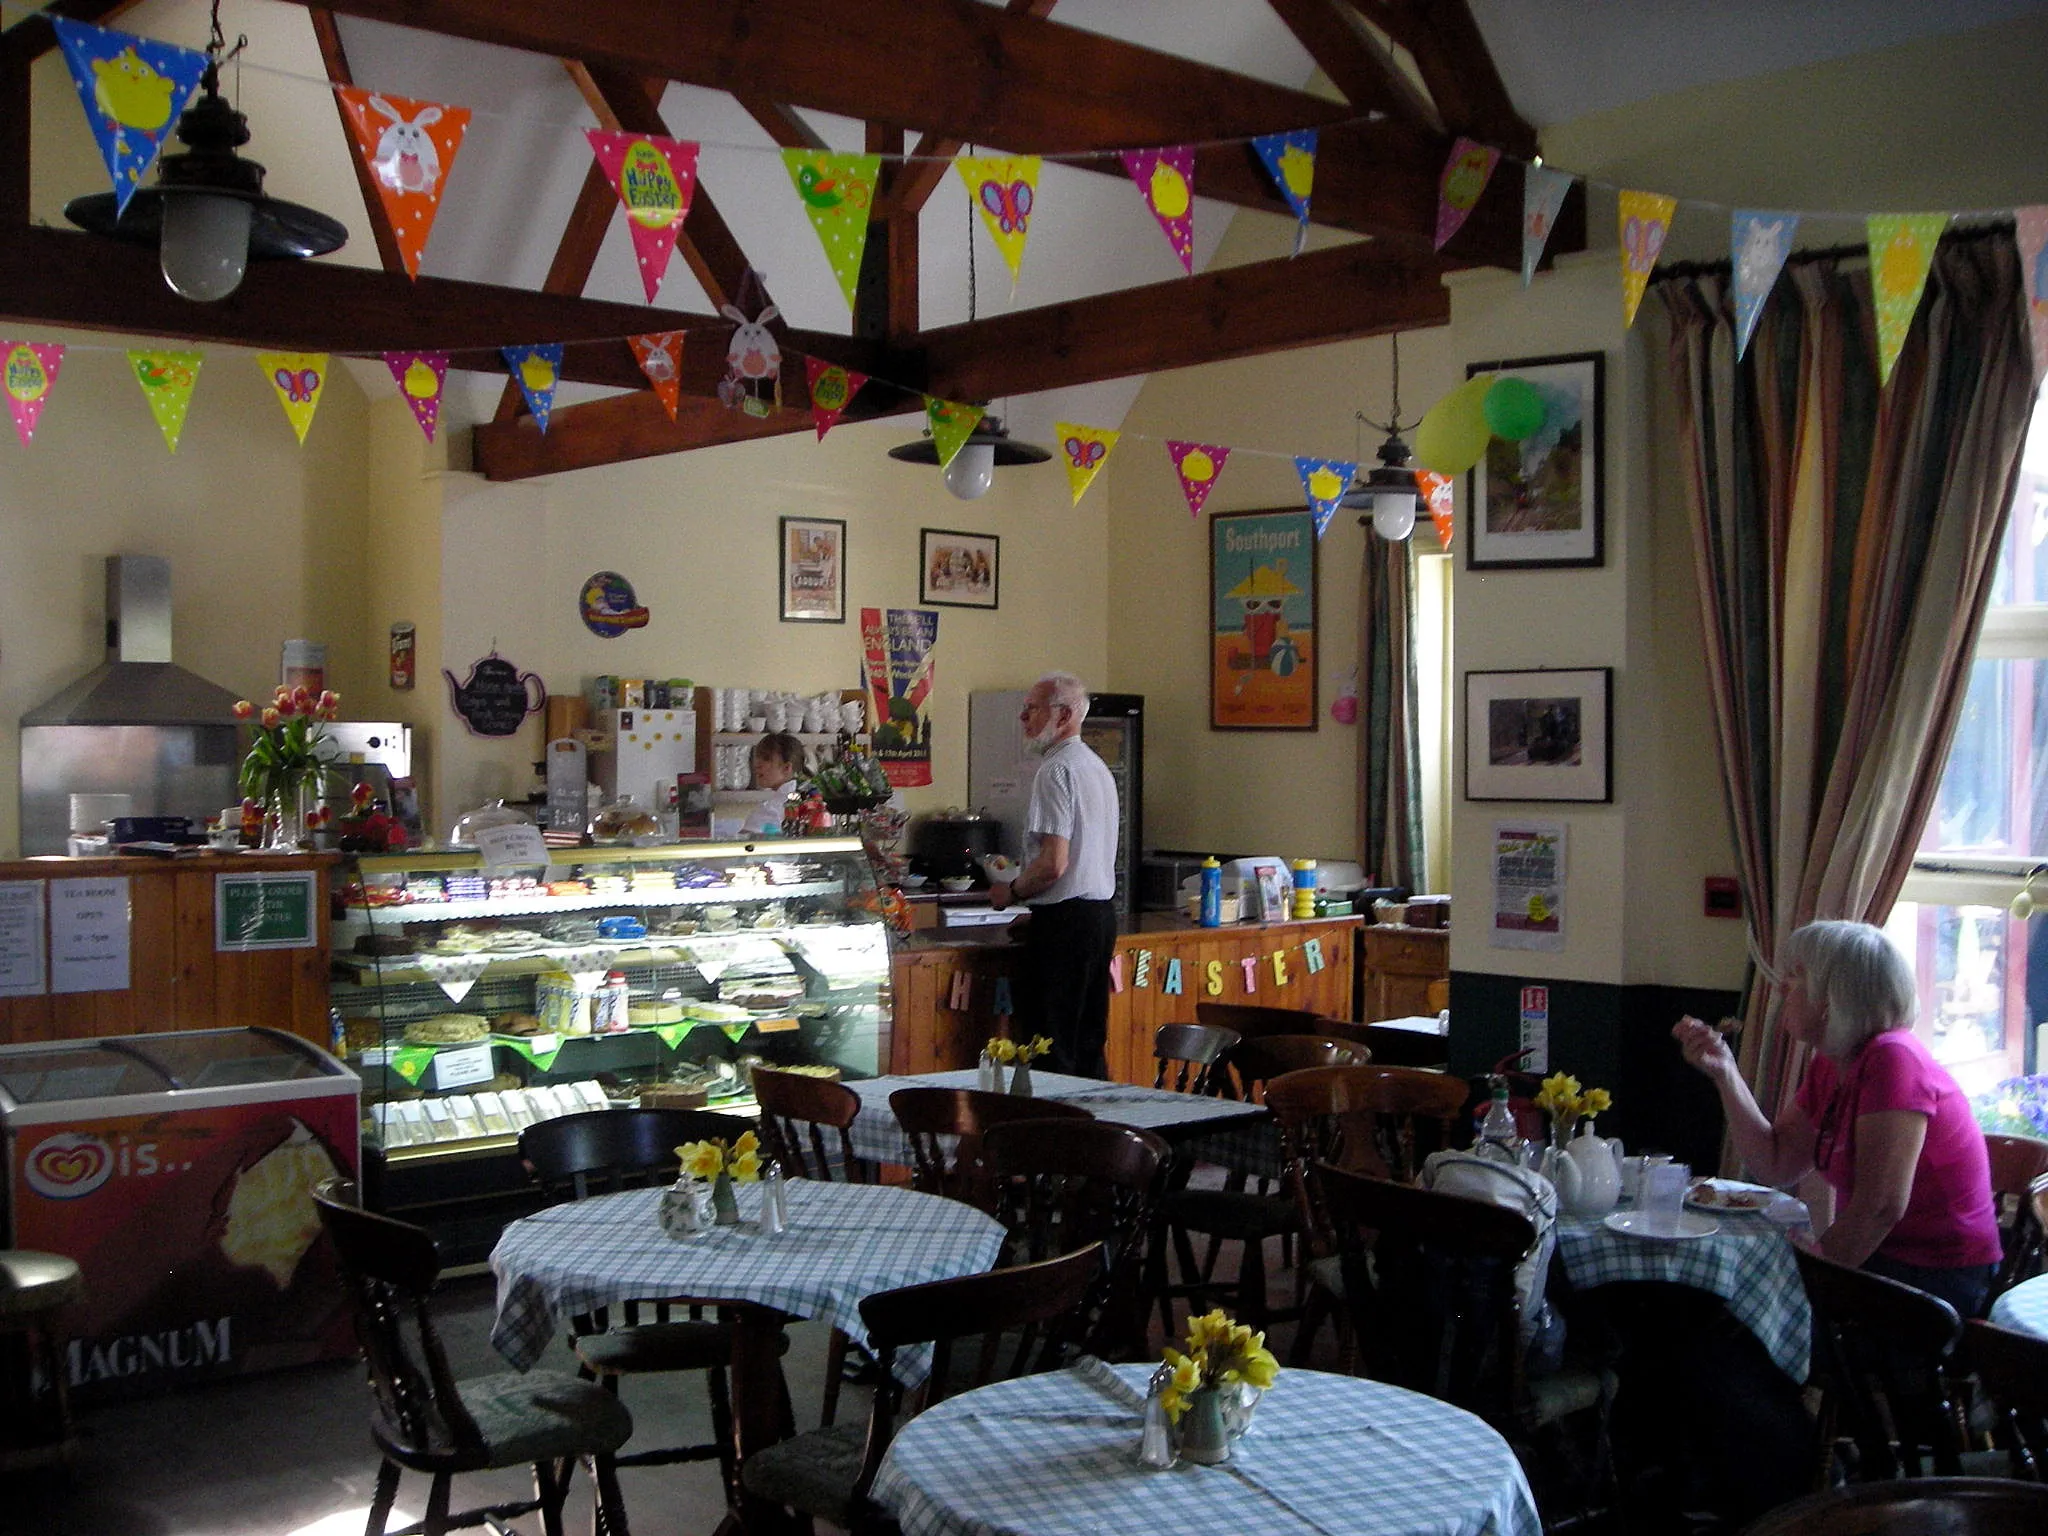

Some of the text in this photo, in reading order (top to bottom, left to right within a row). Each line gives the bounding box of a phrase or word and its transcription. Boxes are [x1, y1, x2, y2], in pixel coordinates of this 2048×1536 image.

[1225, 526, 1301, 553] Southport
[916, 627, 934, 637] AN
[864, 636, 932, 652] ENGLAND
